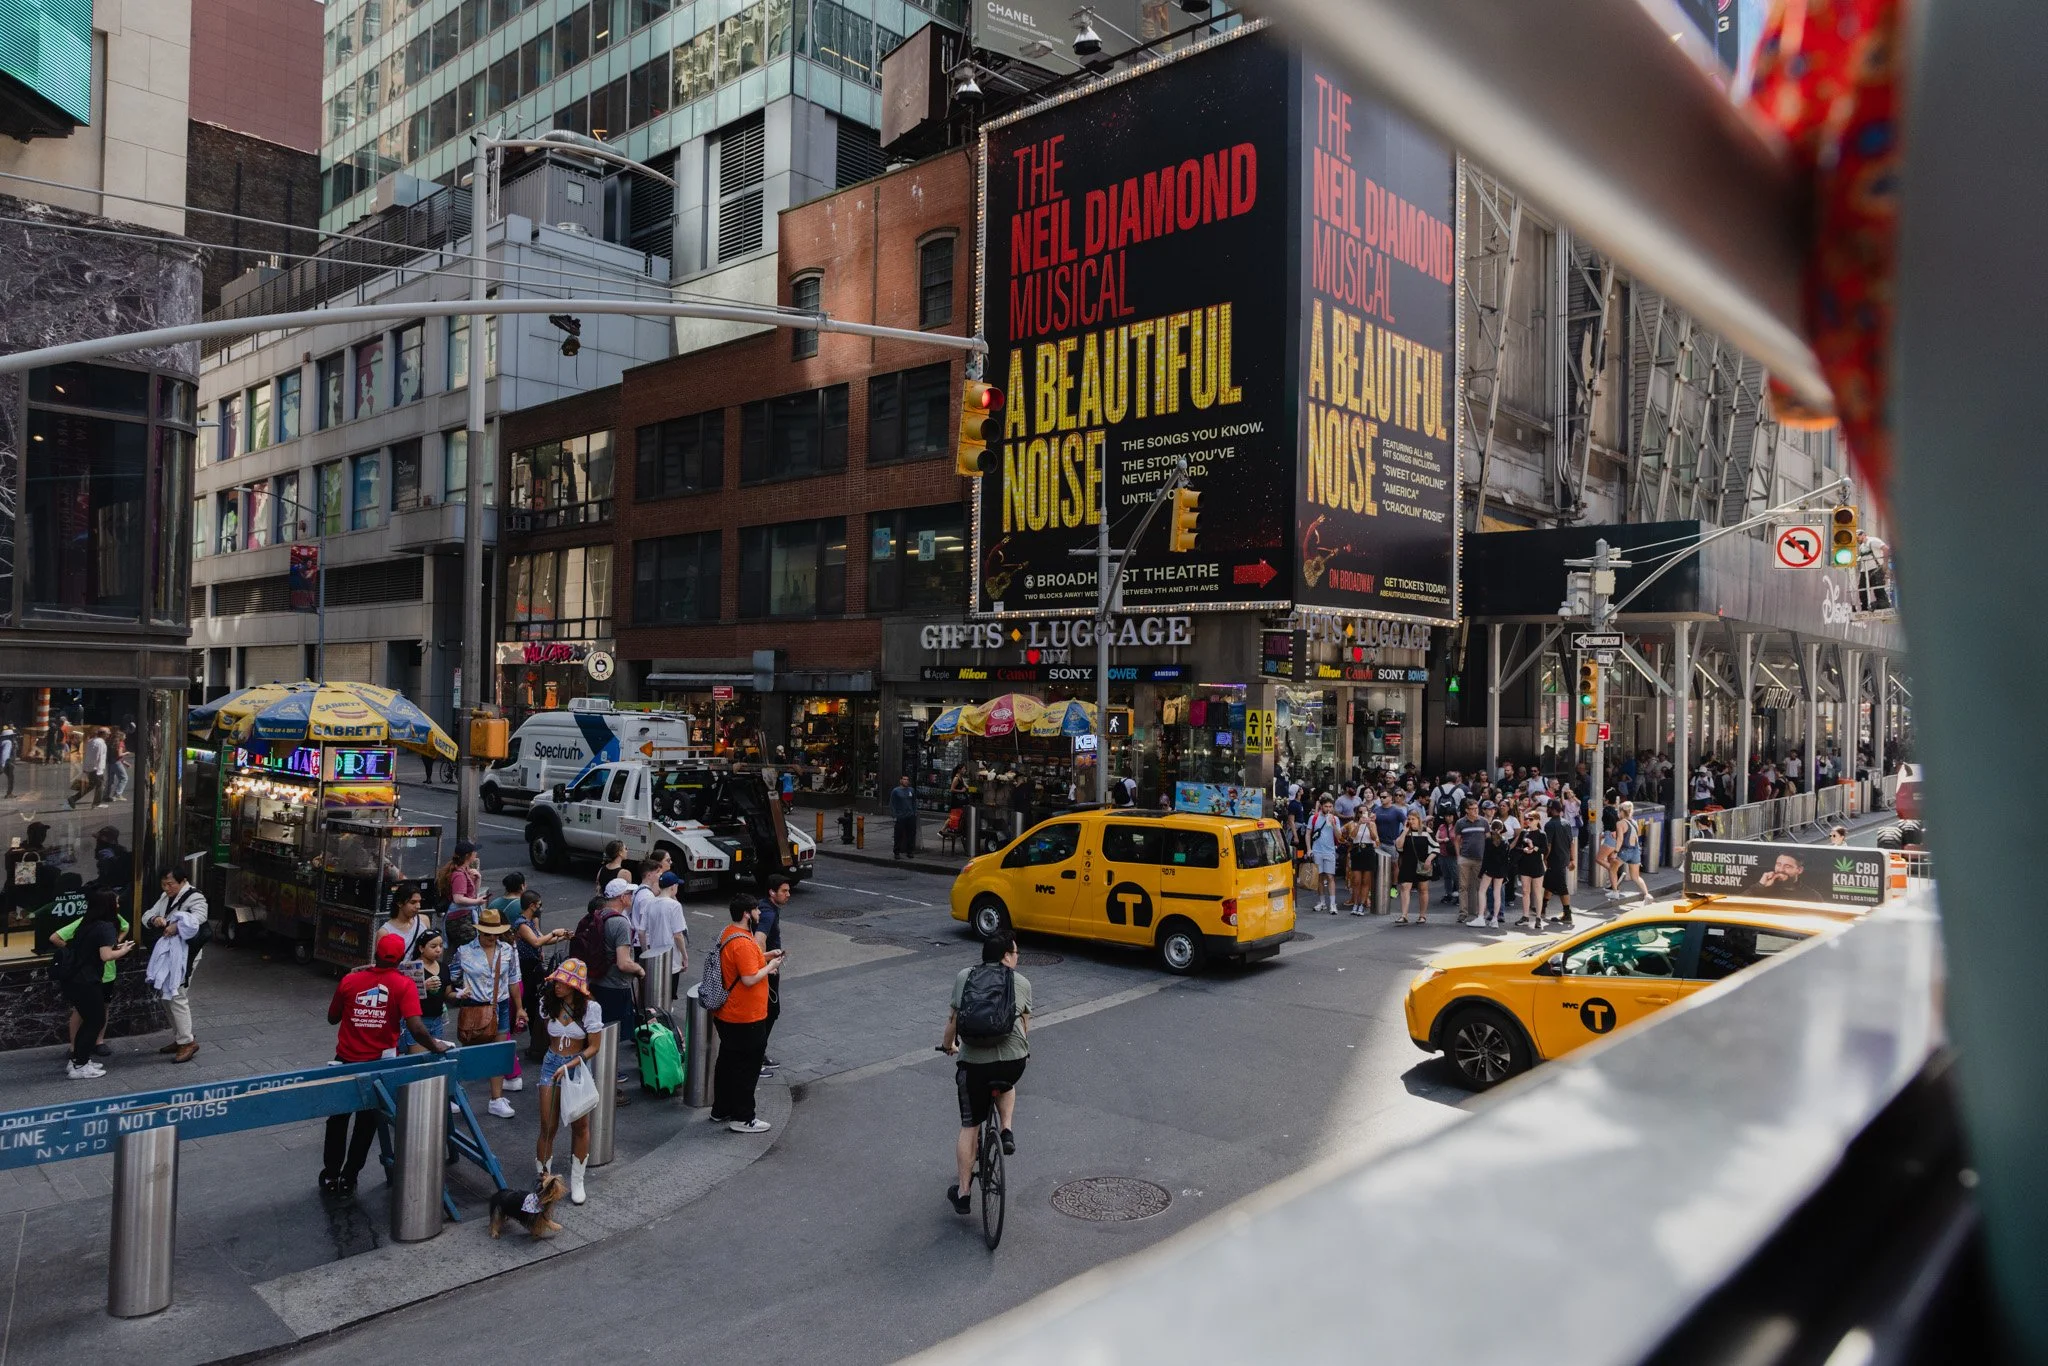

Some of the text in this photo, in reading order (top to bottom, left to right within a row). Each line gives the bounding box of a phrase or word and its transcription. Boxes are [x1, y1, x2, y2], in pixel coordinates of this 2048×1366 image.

[987, 2, 1036, 27] CHANEL
[1314, 74, 1352, 163] THE
[1013, 134, 1065, 210] THE
[1011, 142, 1257, 276] NEIL DIAMOND
[1312, 146, 1454, 287] NEIL DIAMOND
[1312, 222, 1395, 325] MUSICAL
[1009, 250, 1134, 341] MUSICAL
[1004, 301, 1242, 440] A BEAUTIFUL
[1308, 299, 1447, 442] A BEAUTIFUL
[1122, 422, 1264, 452] THE SONGS YOU KNOW.
[1382, 438, 1434, 460] FEATURING ALL HIS
[1122, 460, 1144, 472] THE
[1147, 453, 1187, 468] STORY
[1307, 402, 1378, 518] NOISE
[1382, 449, 1440, 472] HIT SONGS INCLUDING
[1002, 430, 1106, 534] NOISE
[1122, 471, 1160, 485] NEVER
[1410, 472, 1447, 490] CAROLINE"
[1122, 492, 1156, 505] UNTIL
[1382, 482, 1420, 500] "AMERICA"
[1037, 564, 1220, 587] BROADHST THEATRE
[1328, 568, 1375, 594] ON BROADWAY
[1122, 587, 1153, 596] BETWEEN
[1154, 586, 1166, 594] 7TH
[1200, 584, 1219, 592] AVES
[1384, 576, 1447, 594] GET TICKETS TODAY!
[920, 616, 1192, 650] GIFTS LUGGAGE
[1356, 618, 1432, 650] LUGGAGE
[1040, 650, 1069, 664] NY
[931, 670, 950, 680] Apple
[958, 668, 988, 680] Nikon
[996, 668, 1038, 680] Canon
[1049, 668, 1092, 680] SONY
[1108, 668, 1139, 680] OWER
[1154, 670, 1179, 678] SAMSUNG
[1318, 664, 1342, 678] Nikon
[1345, 666, 1374, 681] Canon
[1378, 668, 1406, 680] SONY
[1407, 670, 1430, 682] BOWER
[318, 702, 361, 712] SABRETT
[313, 724, 384, 736] SABRETT
[1247, 712, 1260, 747] ATM
[1265, 712, 1273, 747] ATM
[435, 736, 456, 758] ABRETT
[534, 742, 580, 760] Spectrum
[1691, 851, 1758, 866] YOUR FIRST TIME
[1690, 862, 1748, 876] DOESN'T HAVE
[1856, 862, 1879, 874] CBD
[1690, 873, 1743, 887] TO BE SCARY.
[1832, 873, 1880, 888] KRATOM
[1035, 884, 1056, 895] NYC
[1840, 894, 1850, 902] NYC
[52, 900, 88, 917] 40%
[1116, 892, 1142, 926] T
[354, 1008, 386, 1016] TOPVIEW
[1562, 1002, 1579, 1010] NYC
[1587, 1004, 1608, 1030] T
[171, 1093, 195, 1105] DO
[204, 1085, 239, 1102] NOT
[0, 1100, 228, 1150] LINE DO NOT CROSS
[36, 1138, 107, 1159] NYPD
